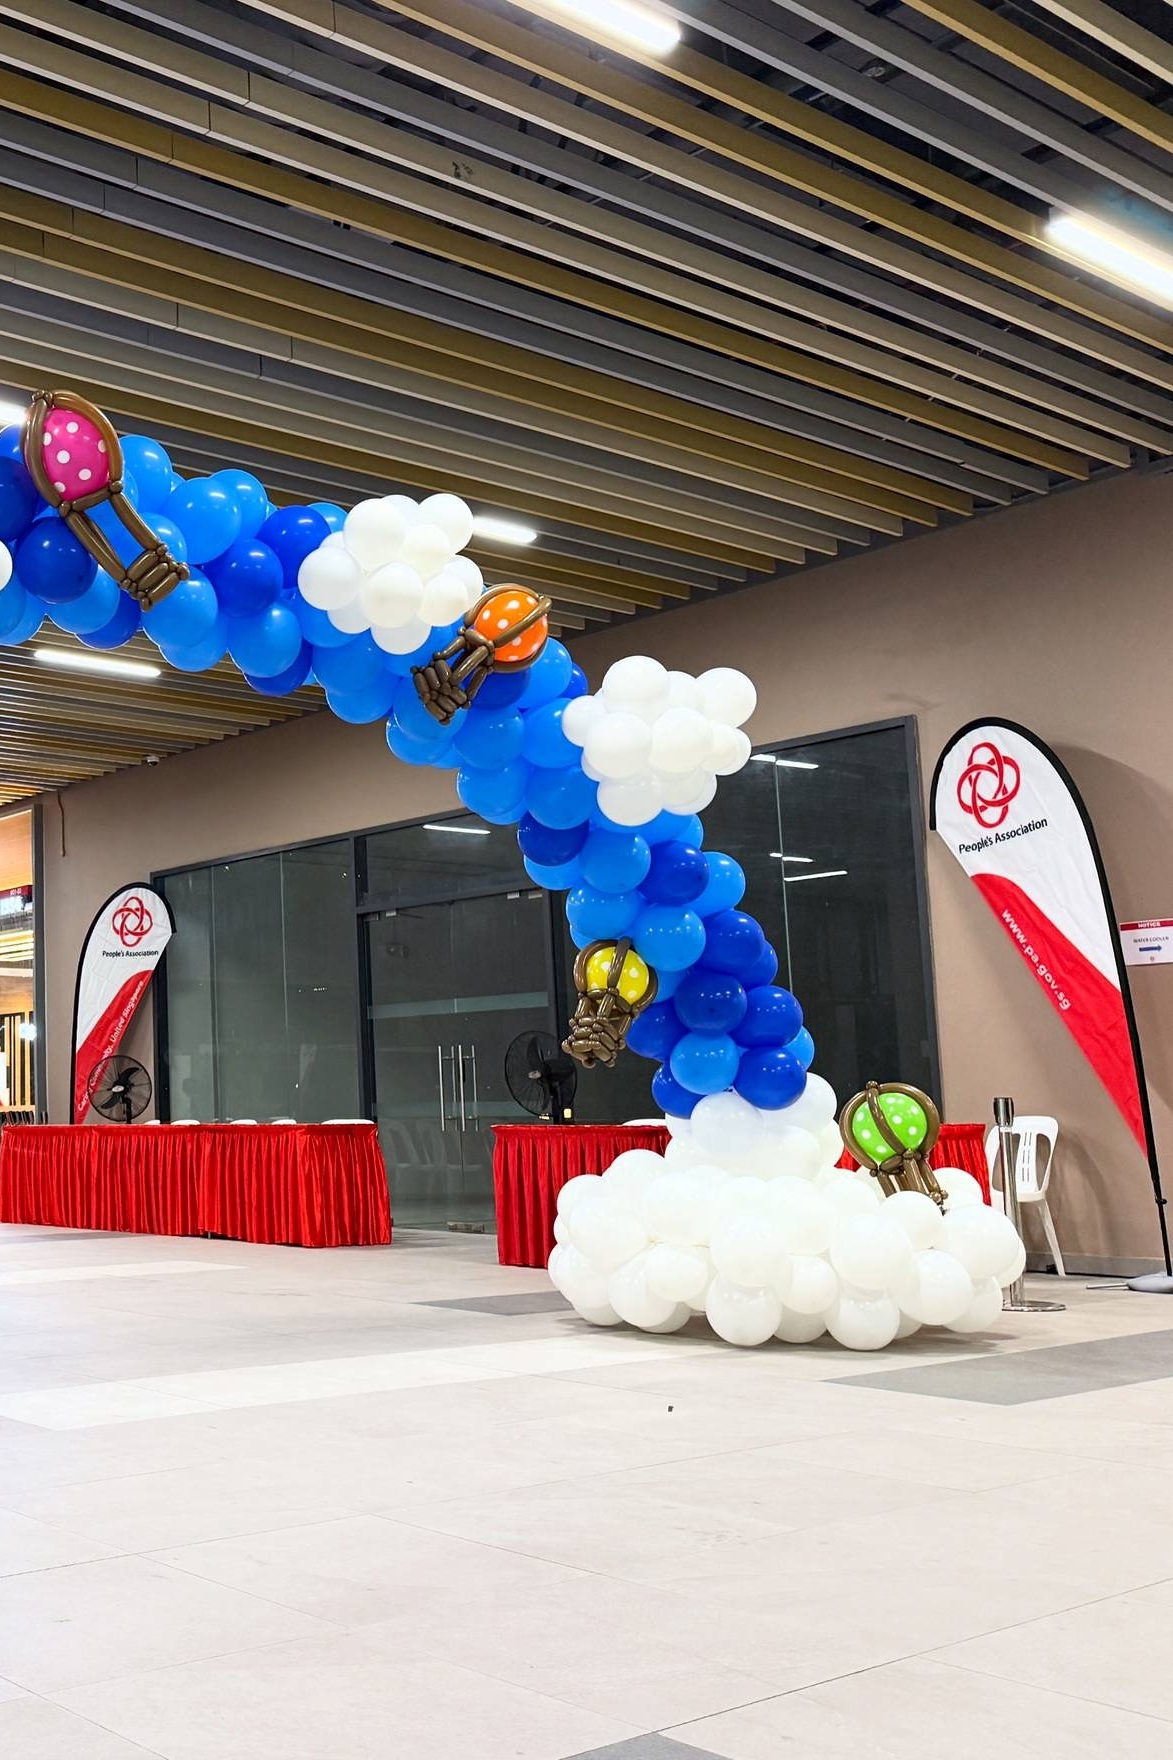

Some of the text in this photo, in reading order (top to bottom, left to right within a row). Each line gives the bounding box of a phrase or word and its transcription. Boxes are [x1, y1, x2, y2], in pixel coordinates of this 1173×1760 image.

[958, 818, 1049, 854] People's Association
[102, 950, 125, 958] People's
[1002, 909, 1071, 1010] www.pa.gov.sg
[109, 1016, 126, 1042] United
[122, 980, 144, 1018] Singapore
